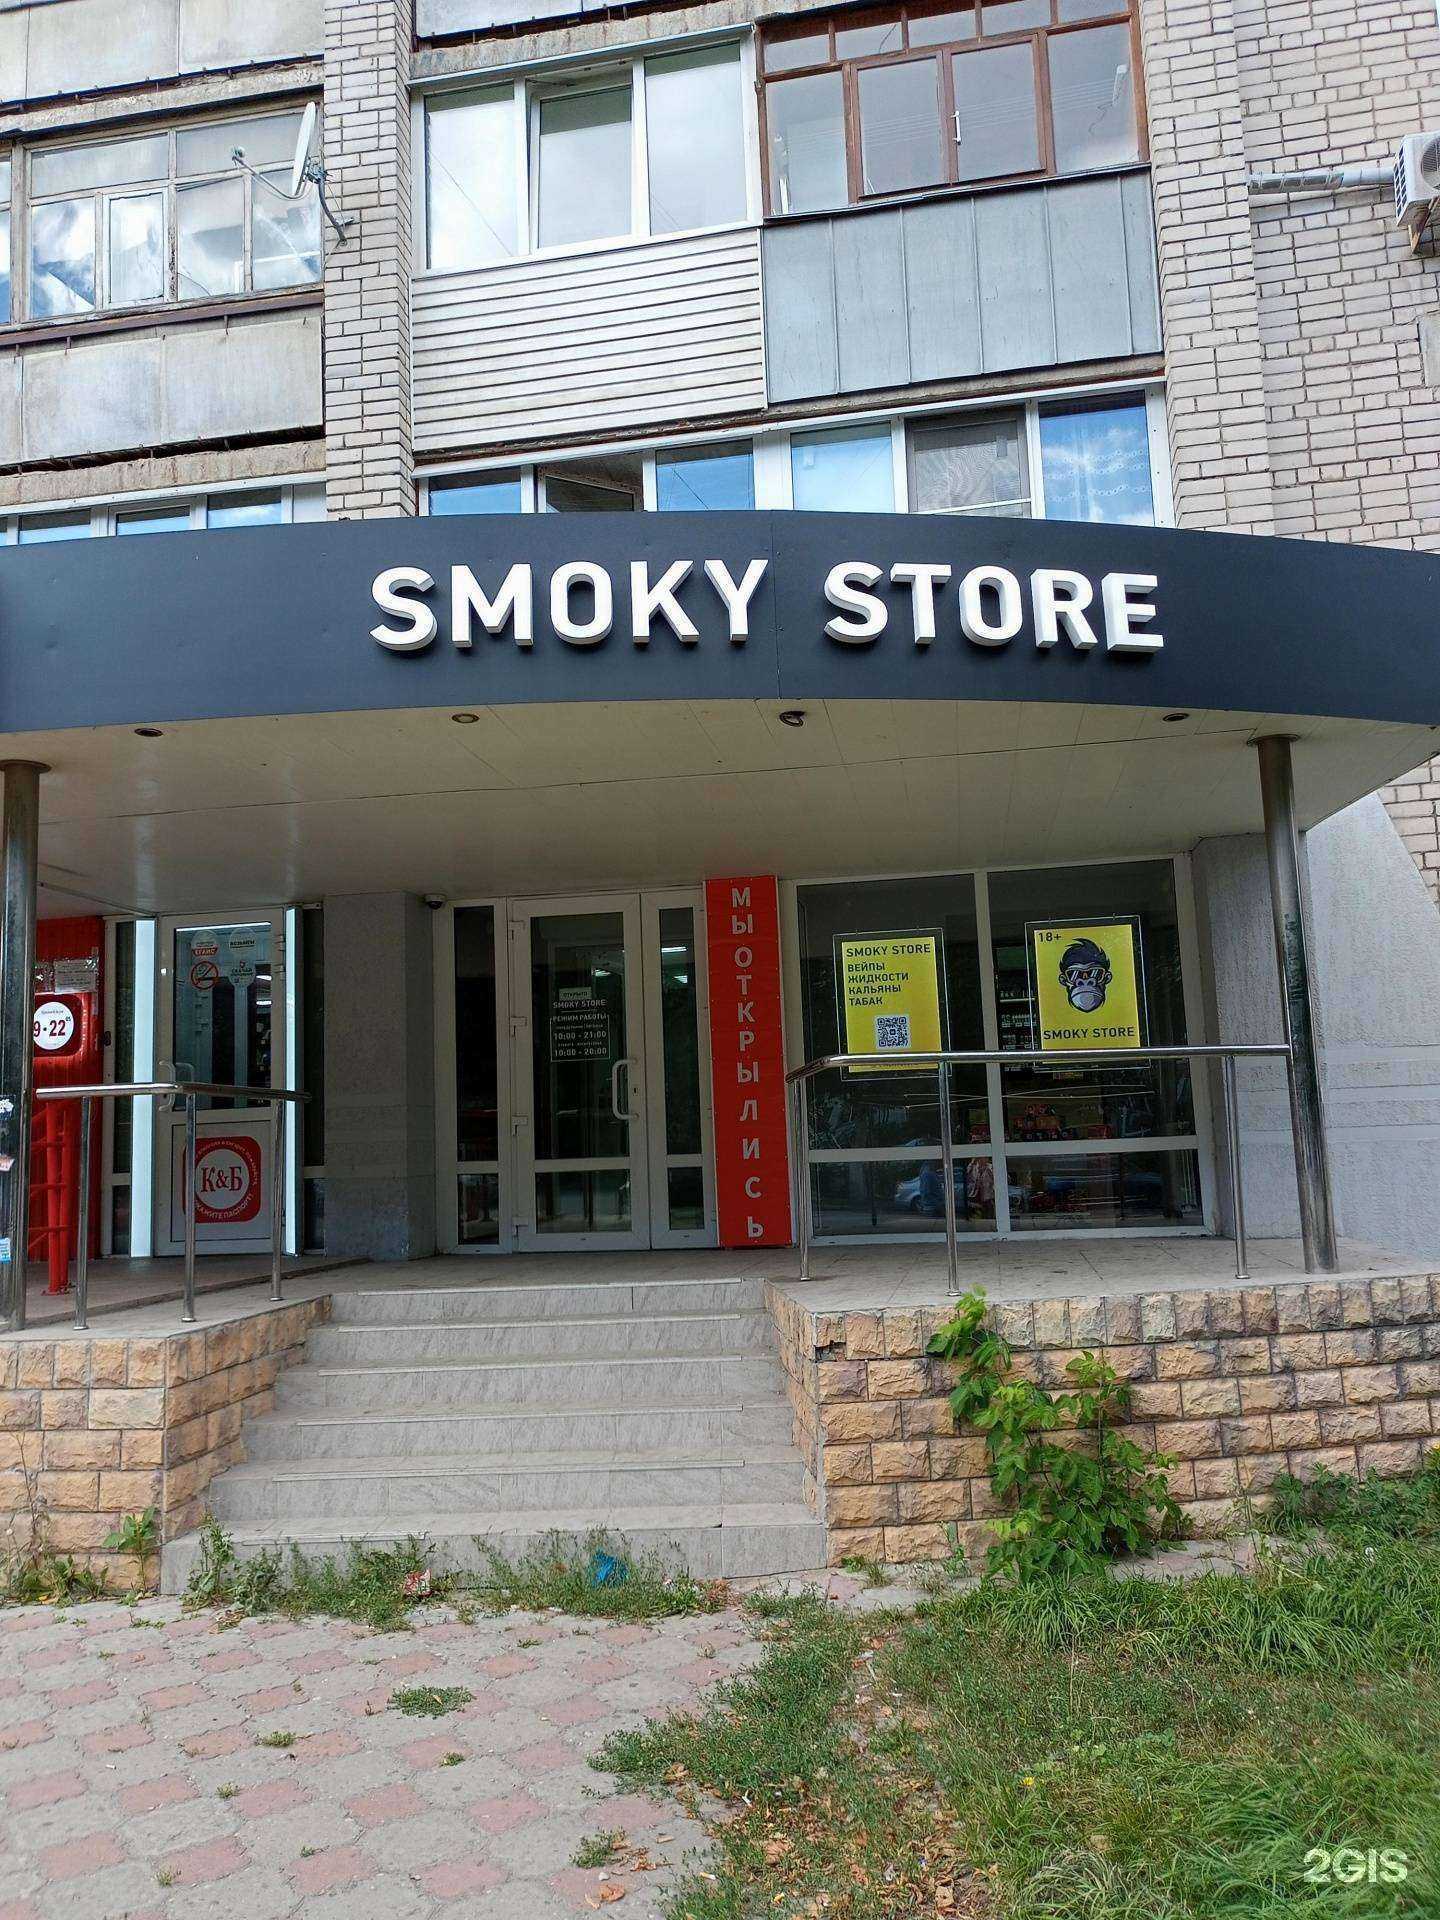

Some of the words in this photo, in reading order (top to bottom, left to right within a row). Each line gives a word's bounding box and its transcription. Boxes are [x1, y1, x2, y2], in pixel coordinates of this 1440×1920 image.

[369, 559, 768, 652] SMOKY
[824, 561, 1164, 653] STORE
[730, 887, 754, 935] МЫ
[1038, 932, 1062, 942] 18+
[846, 946, 888, 957] SMOKY
[892, 943, 931, 955] STORE
[847, 961, 885, 972] ВЕЙПЫ
[848, 972, 909, 984] ЖИДКОСТИ
[848, 985, 902, 995] КАЛЬЯНЫ
[552, 1001, 579, 1009] SMOKY
[581, 999, 607, 1008] STORE
[848, 996, 883, 1006] ТАБАК
[552, 1014, 579, 1022] РЕЖИМ
[579, 1012, 607, 1021] РАБОТЫ
[553, 1032, 576, 1040] 10:00
[583, 1030, 607, 1039] 21:00
[1043, 1028, 1089, 1040] SMOKY
[1092, 1026, 1135, 1038] STORE
[554, 1048, 577, 1057] 10:00
[734, 946, 764, 1239] ОТКРЫЛИСЬ
[200, 1166, 243, 1192] К&Б
